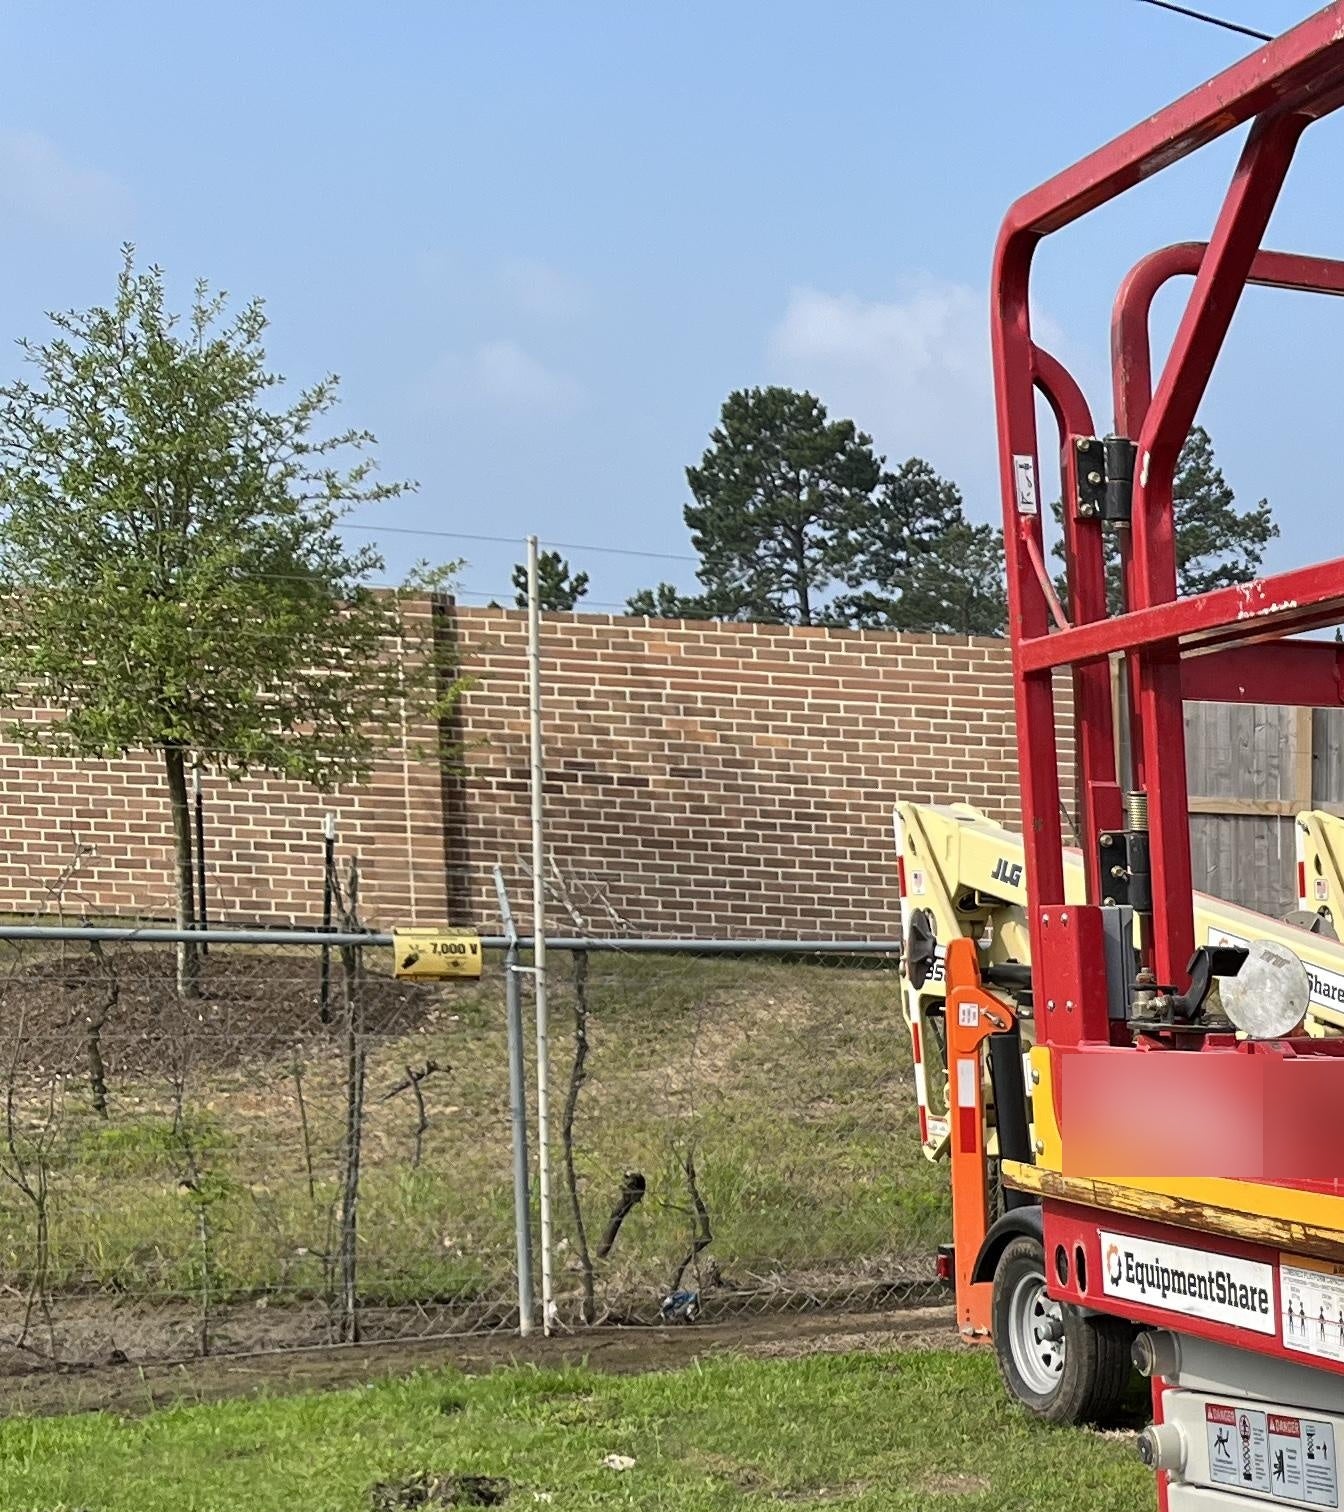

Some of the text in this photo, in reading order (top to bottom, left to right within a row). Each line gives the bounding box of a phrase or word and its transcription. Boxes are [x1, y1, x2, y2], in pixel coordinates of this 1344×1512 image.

[991, 858, 1023, 888] JLG
[429, 942, 478, 956] 7,000 V
[1123, 1251, 1269, 1315] EquipmentShare
[1274, 1420, 1300, 1437] DANGER
